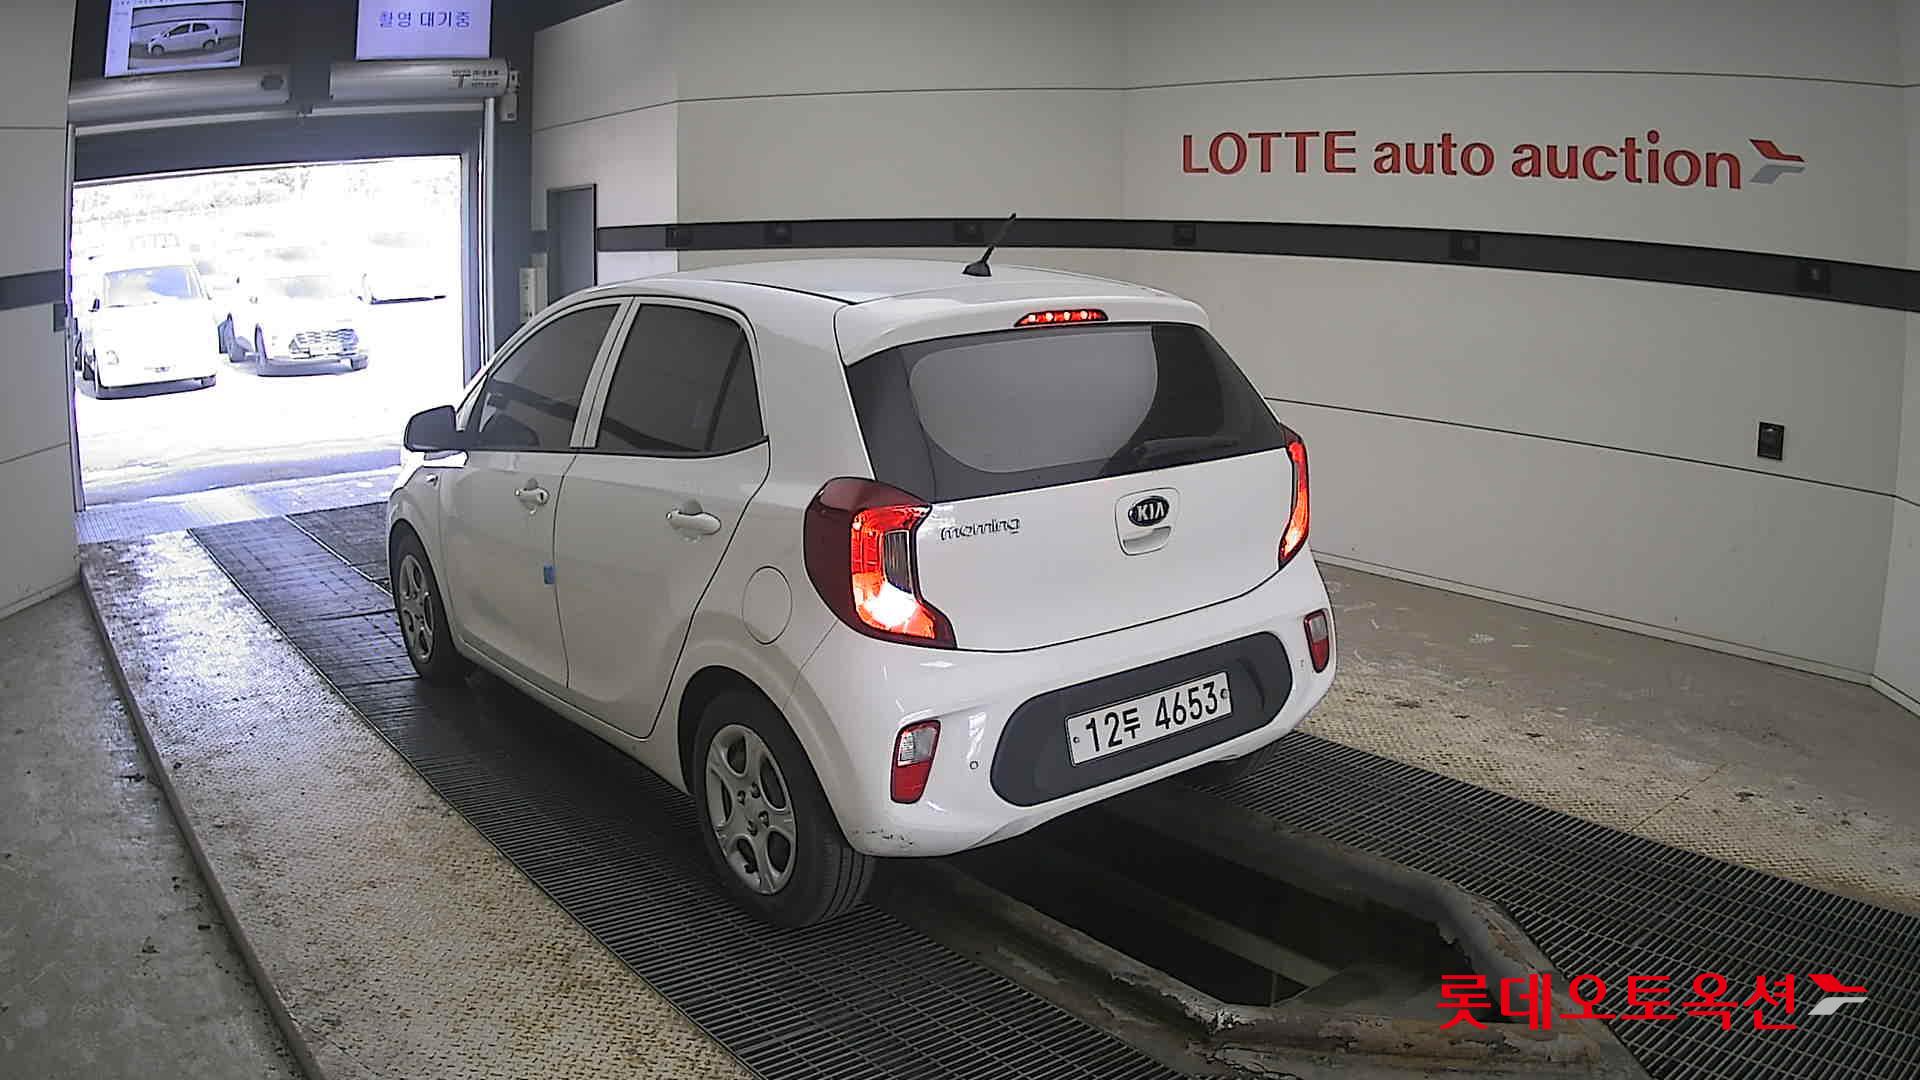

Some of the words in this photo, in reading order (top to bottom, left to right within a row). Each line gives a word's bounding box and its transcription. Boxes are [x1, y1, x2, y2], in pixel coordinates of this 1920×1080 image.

[420, 10, 471, 28] 대기중
[1183, 130, 1357, 174] LOTTE
[1373, 132, 1495, 177] auto
[1512, 130, 1741, 189] auction
[1135, 501, 1166, 522] KIA
[1086, 707, 1141, 752] 12두
[1155, 681, 1218, 730] 4653
